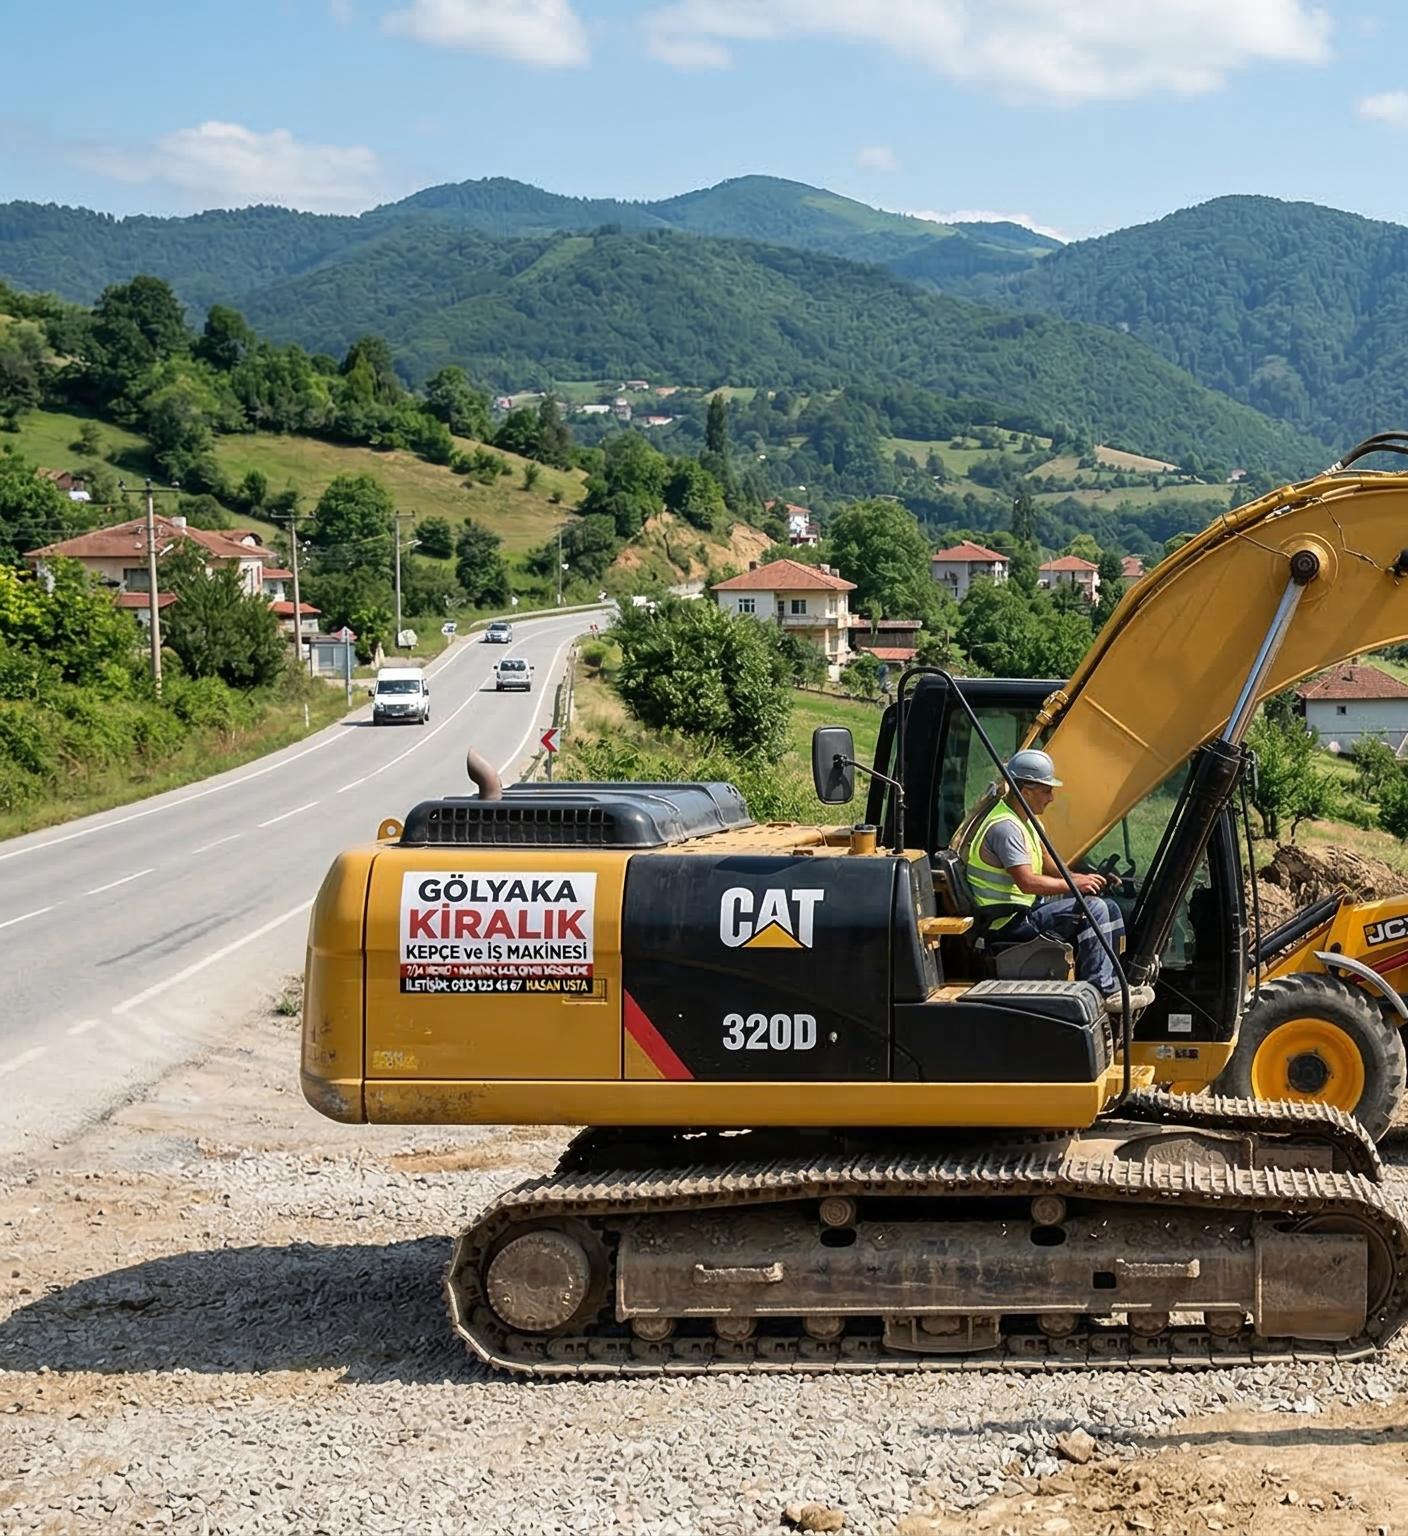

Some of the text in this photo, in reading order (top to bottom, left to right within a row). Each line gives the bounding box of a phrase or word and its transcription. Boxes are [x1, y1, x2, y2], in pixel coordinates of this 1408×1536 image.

[418, 873, 578, 903] GÖLYAKA
[409, 903, 586, 940] KİRALIK
[719, 887, 825, 948] CAT
[406, 941, 588, 962] KEPÇE ve İŞ MAKİNESİ
[562, 979, 589, 991] USTA
[722, 1013, 817, 1051] 320D
